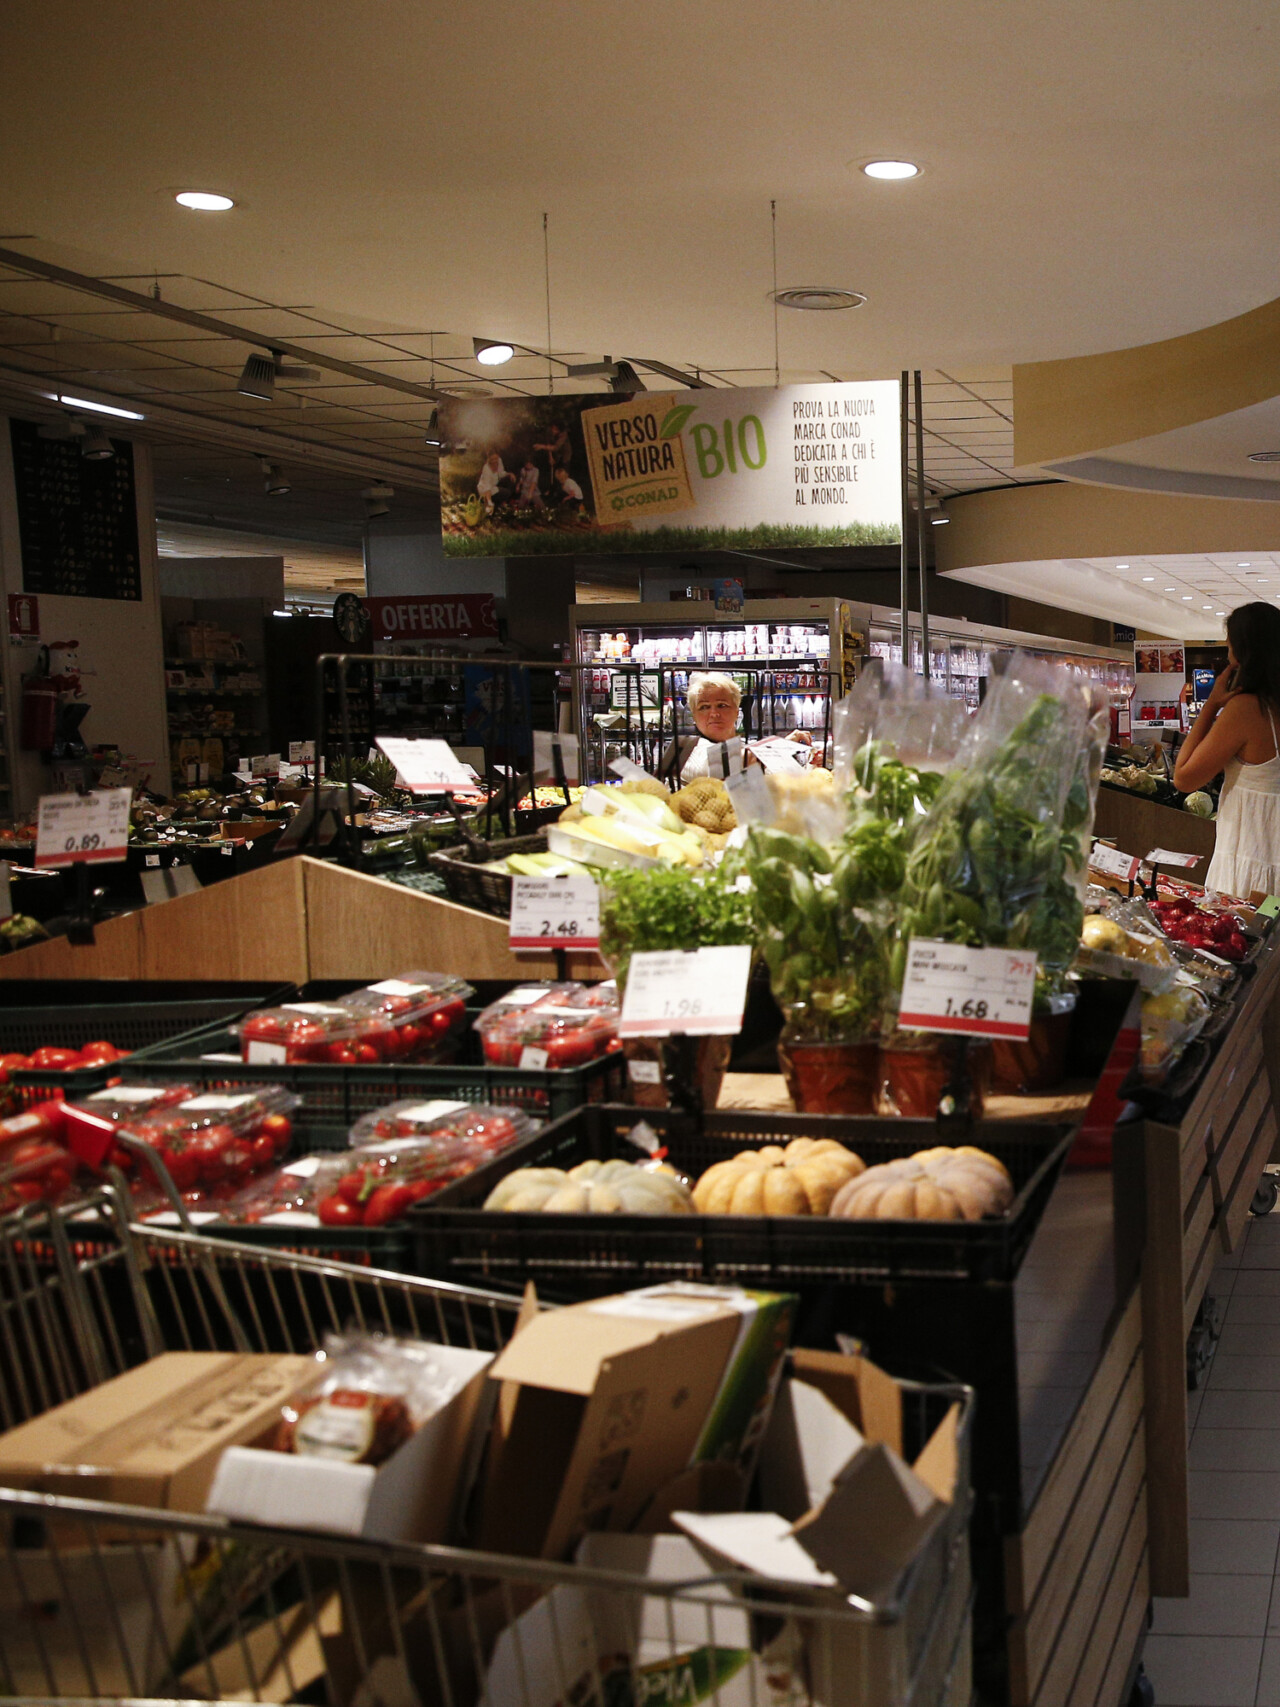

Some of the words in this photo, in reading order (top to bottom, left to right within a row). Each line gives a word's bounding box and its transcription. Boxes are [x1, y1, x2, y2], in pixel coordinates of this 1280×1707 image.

[793, 400, 824, 419] PROVA
[827, 400, 841, 419] LA
[844, 399, 876, 417] NUOVA
[595, 413, 659, 453] VERSO
[794, 423, 826, 441] MARCA
[830, 422, 861, 440] CONAD
[689, 414, 768, 479] BIO
[794, 444, 838, 462] DEDICATA
[841, 443, 850, 460] A
[851, 442, 867, 459] CHI
[870, 438, 876, 459] È
[602, 442, 675, 482] NATURA
[795, 463, 811, 484] PIÙ
[813, 464, 859, 483] SENSIBILE
[624, 486, 679, 508] CONAD
[795, 488, 808, 506] AL
[811, 486, 849, 506] MONDO.
[381, 602, 473, 632] OFFERTA
[1115, 630, 1135, 641] mia
